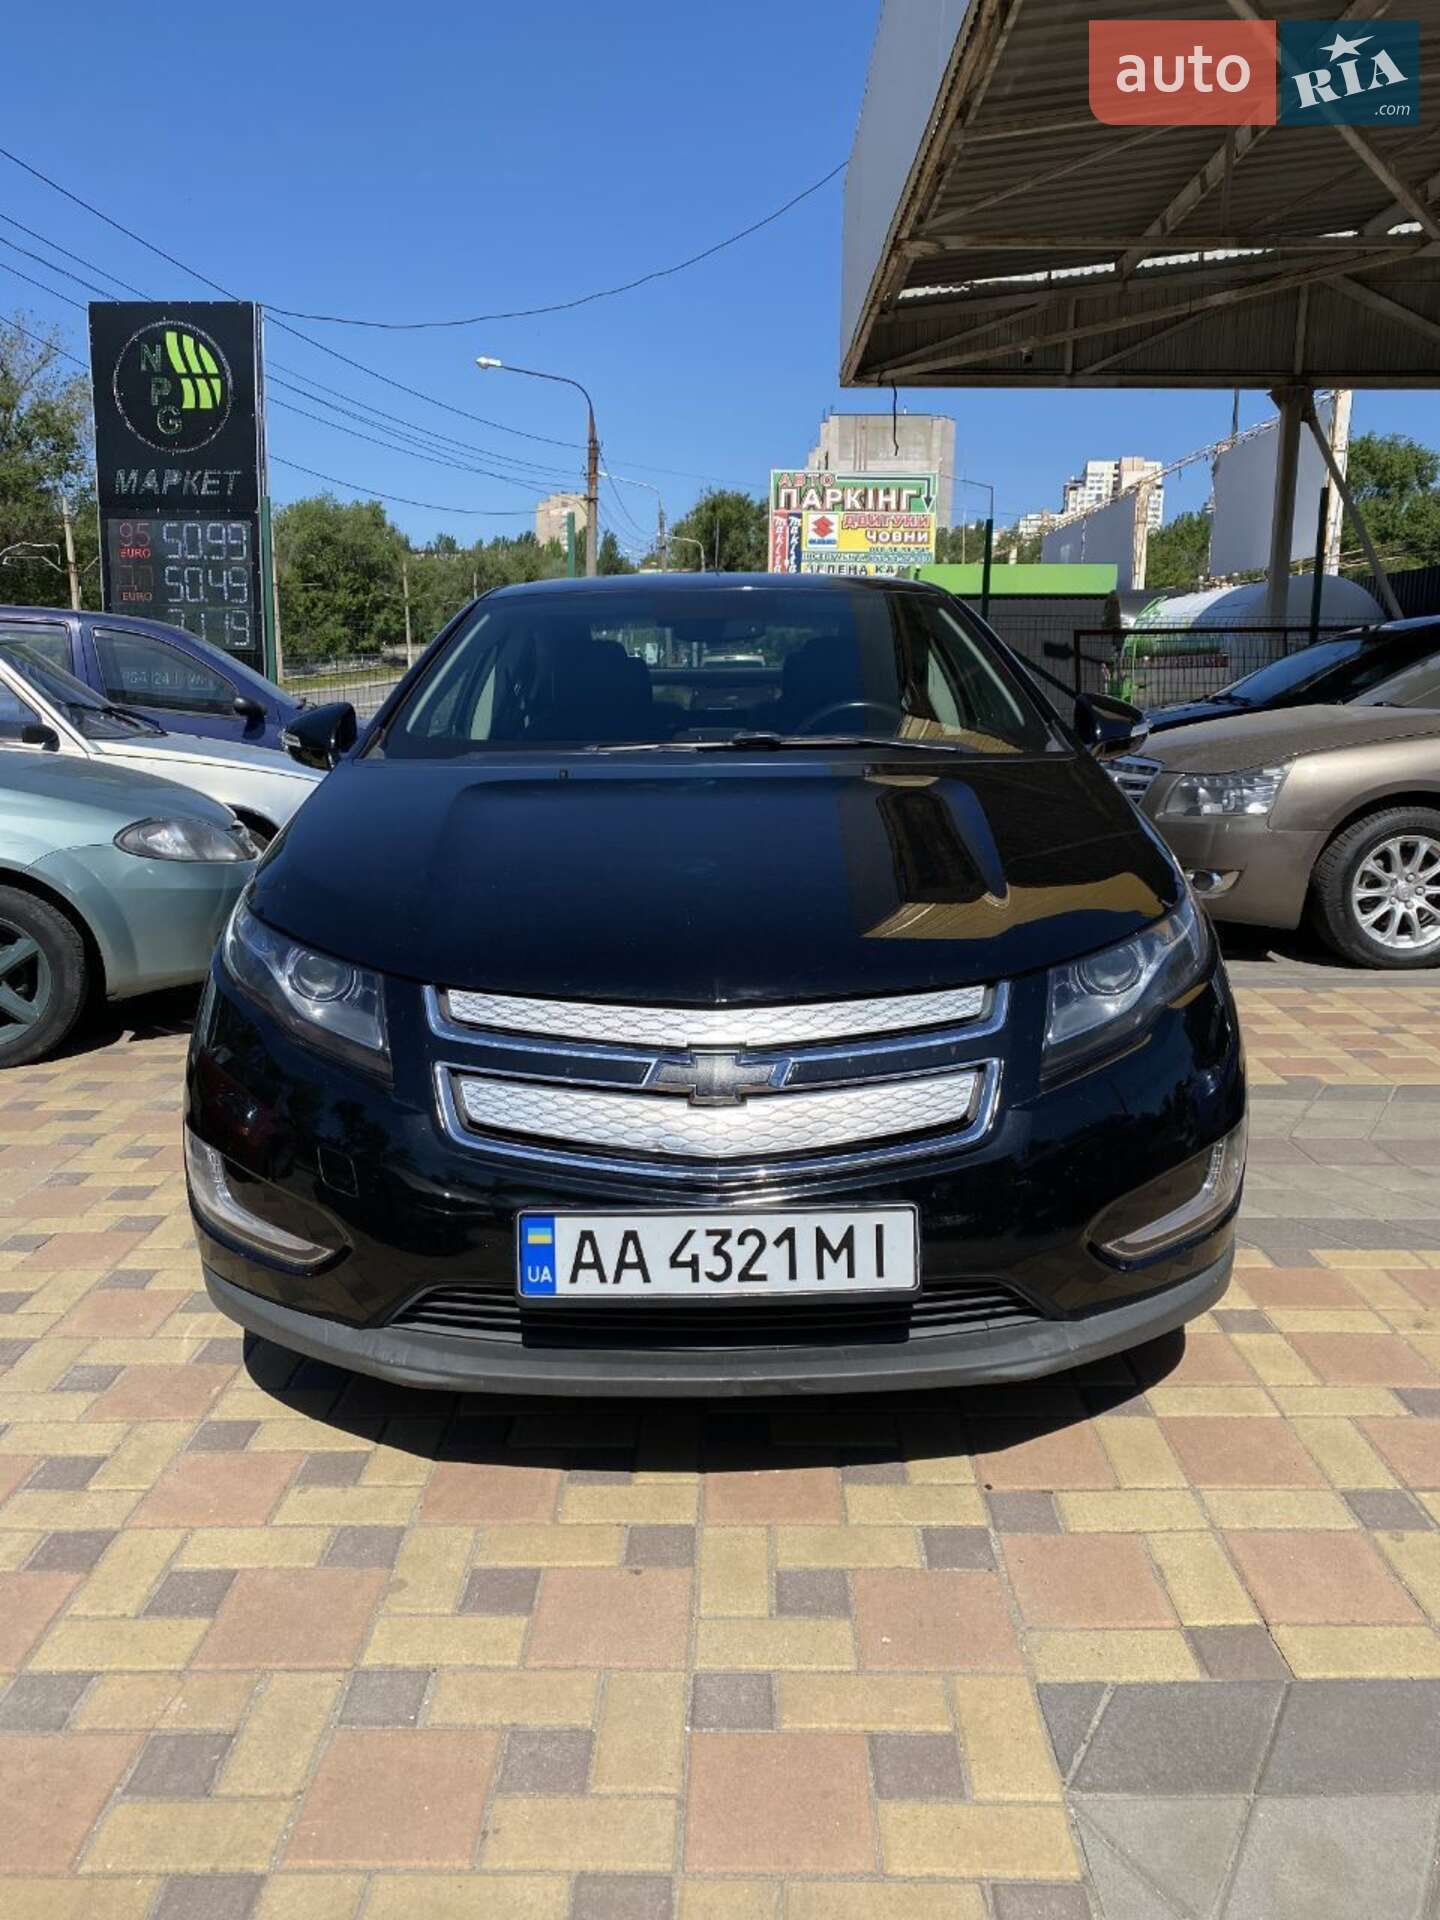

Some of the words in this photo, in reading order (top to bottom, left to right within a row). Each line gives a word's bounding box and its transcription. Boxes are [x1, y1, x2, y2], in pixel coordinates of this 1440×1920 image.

[114, 468, 241, 496] МАРКЕТ
[779, 472, 835, 488] АВТО
[779, 488, 918, 512] ПАРКІНГ
[842, 513, 931, 529] ДВИГУНИ
[119, 522, 151, 547] 95
[163, 522, 247, 561] 50.99
[866, 530, 929, 545] ЧОВНИ
[119, 548, 151, 559] EURO
[165, 566, 248, 604] 50.49
[122, 591, 153, 602] EURO
[569, 1229, 652, 1284] AA
[669, 1225, 798, 1284] 4321
[815, 1223, 885, 1281] MI
[527, 1264, 553, 1283] UA
